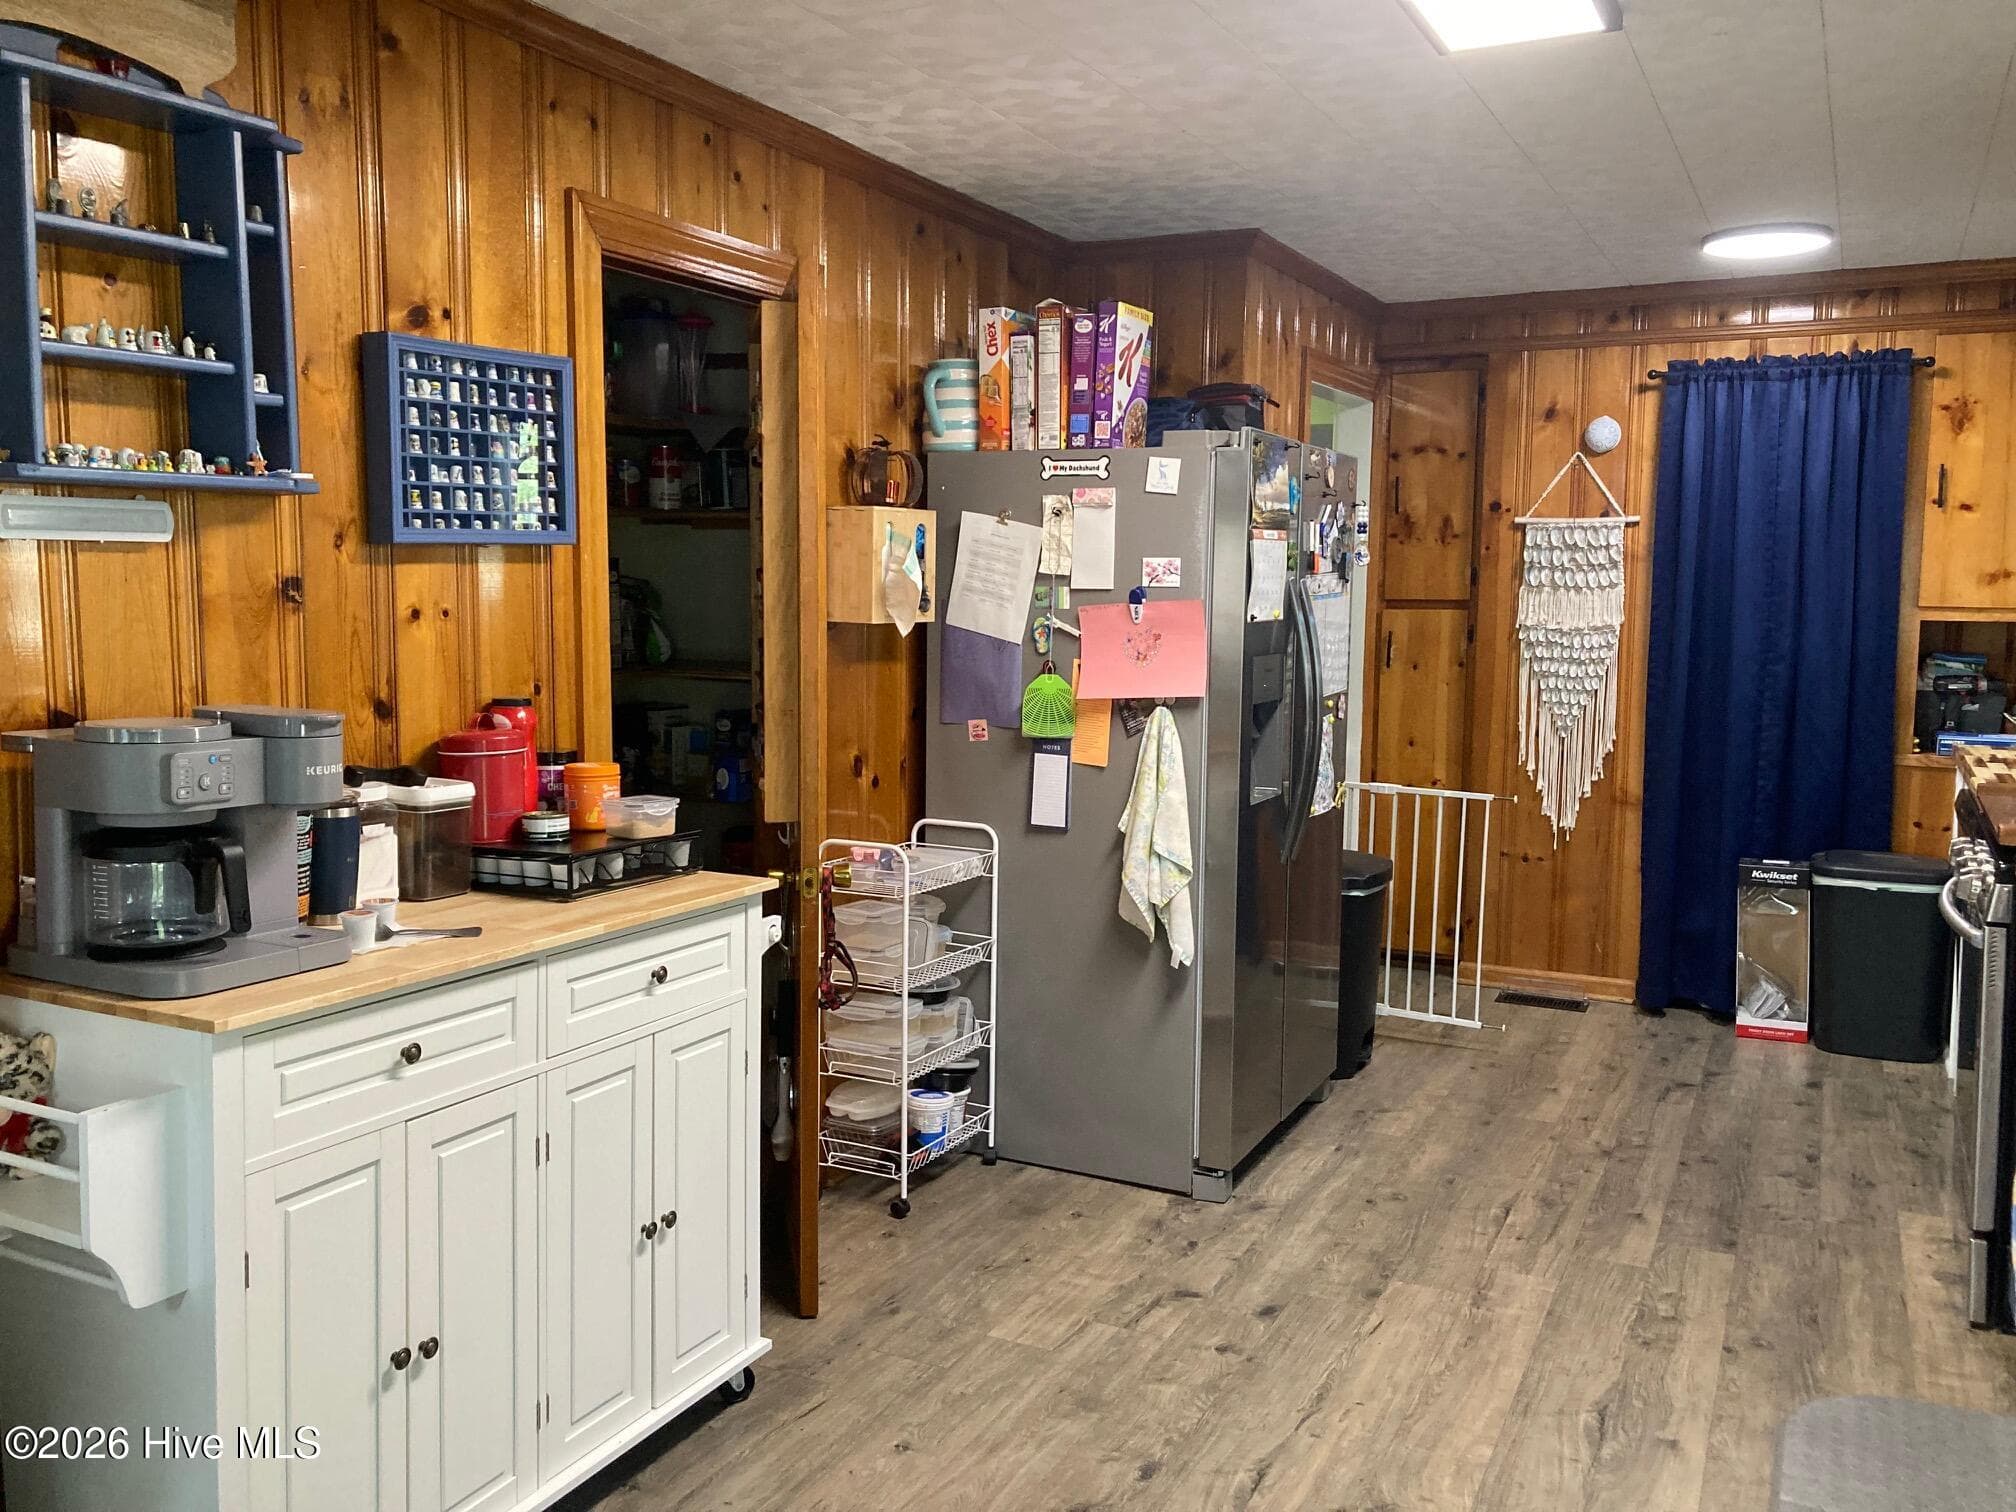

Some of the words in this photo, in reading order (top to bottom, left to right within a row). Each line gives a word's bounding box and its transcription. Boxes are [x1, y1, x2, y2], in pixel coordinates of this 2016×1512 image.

[986, 320, 999, 357] Chex
[1059, 465, 1068, 473] My
[1068, 464, 1100, 472] Dachshund
[1751, 869, 1799, 881] Kwikset
